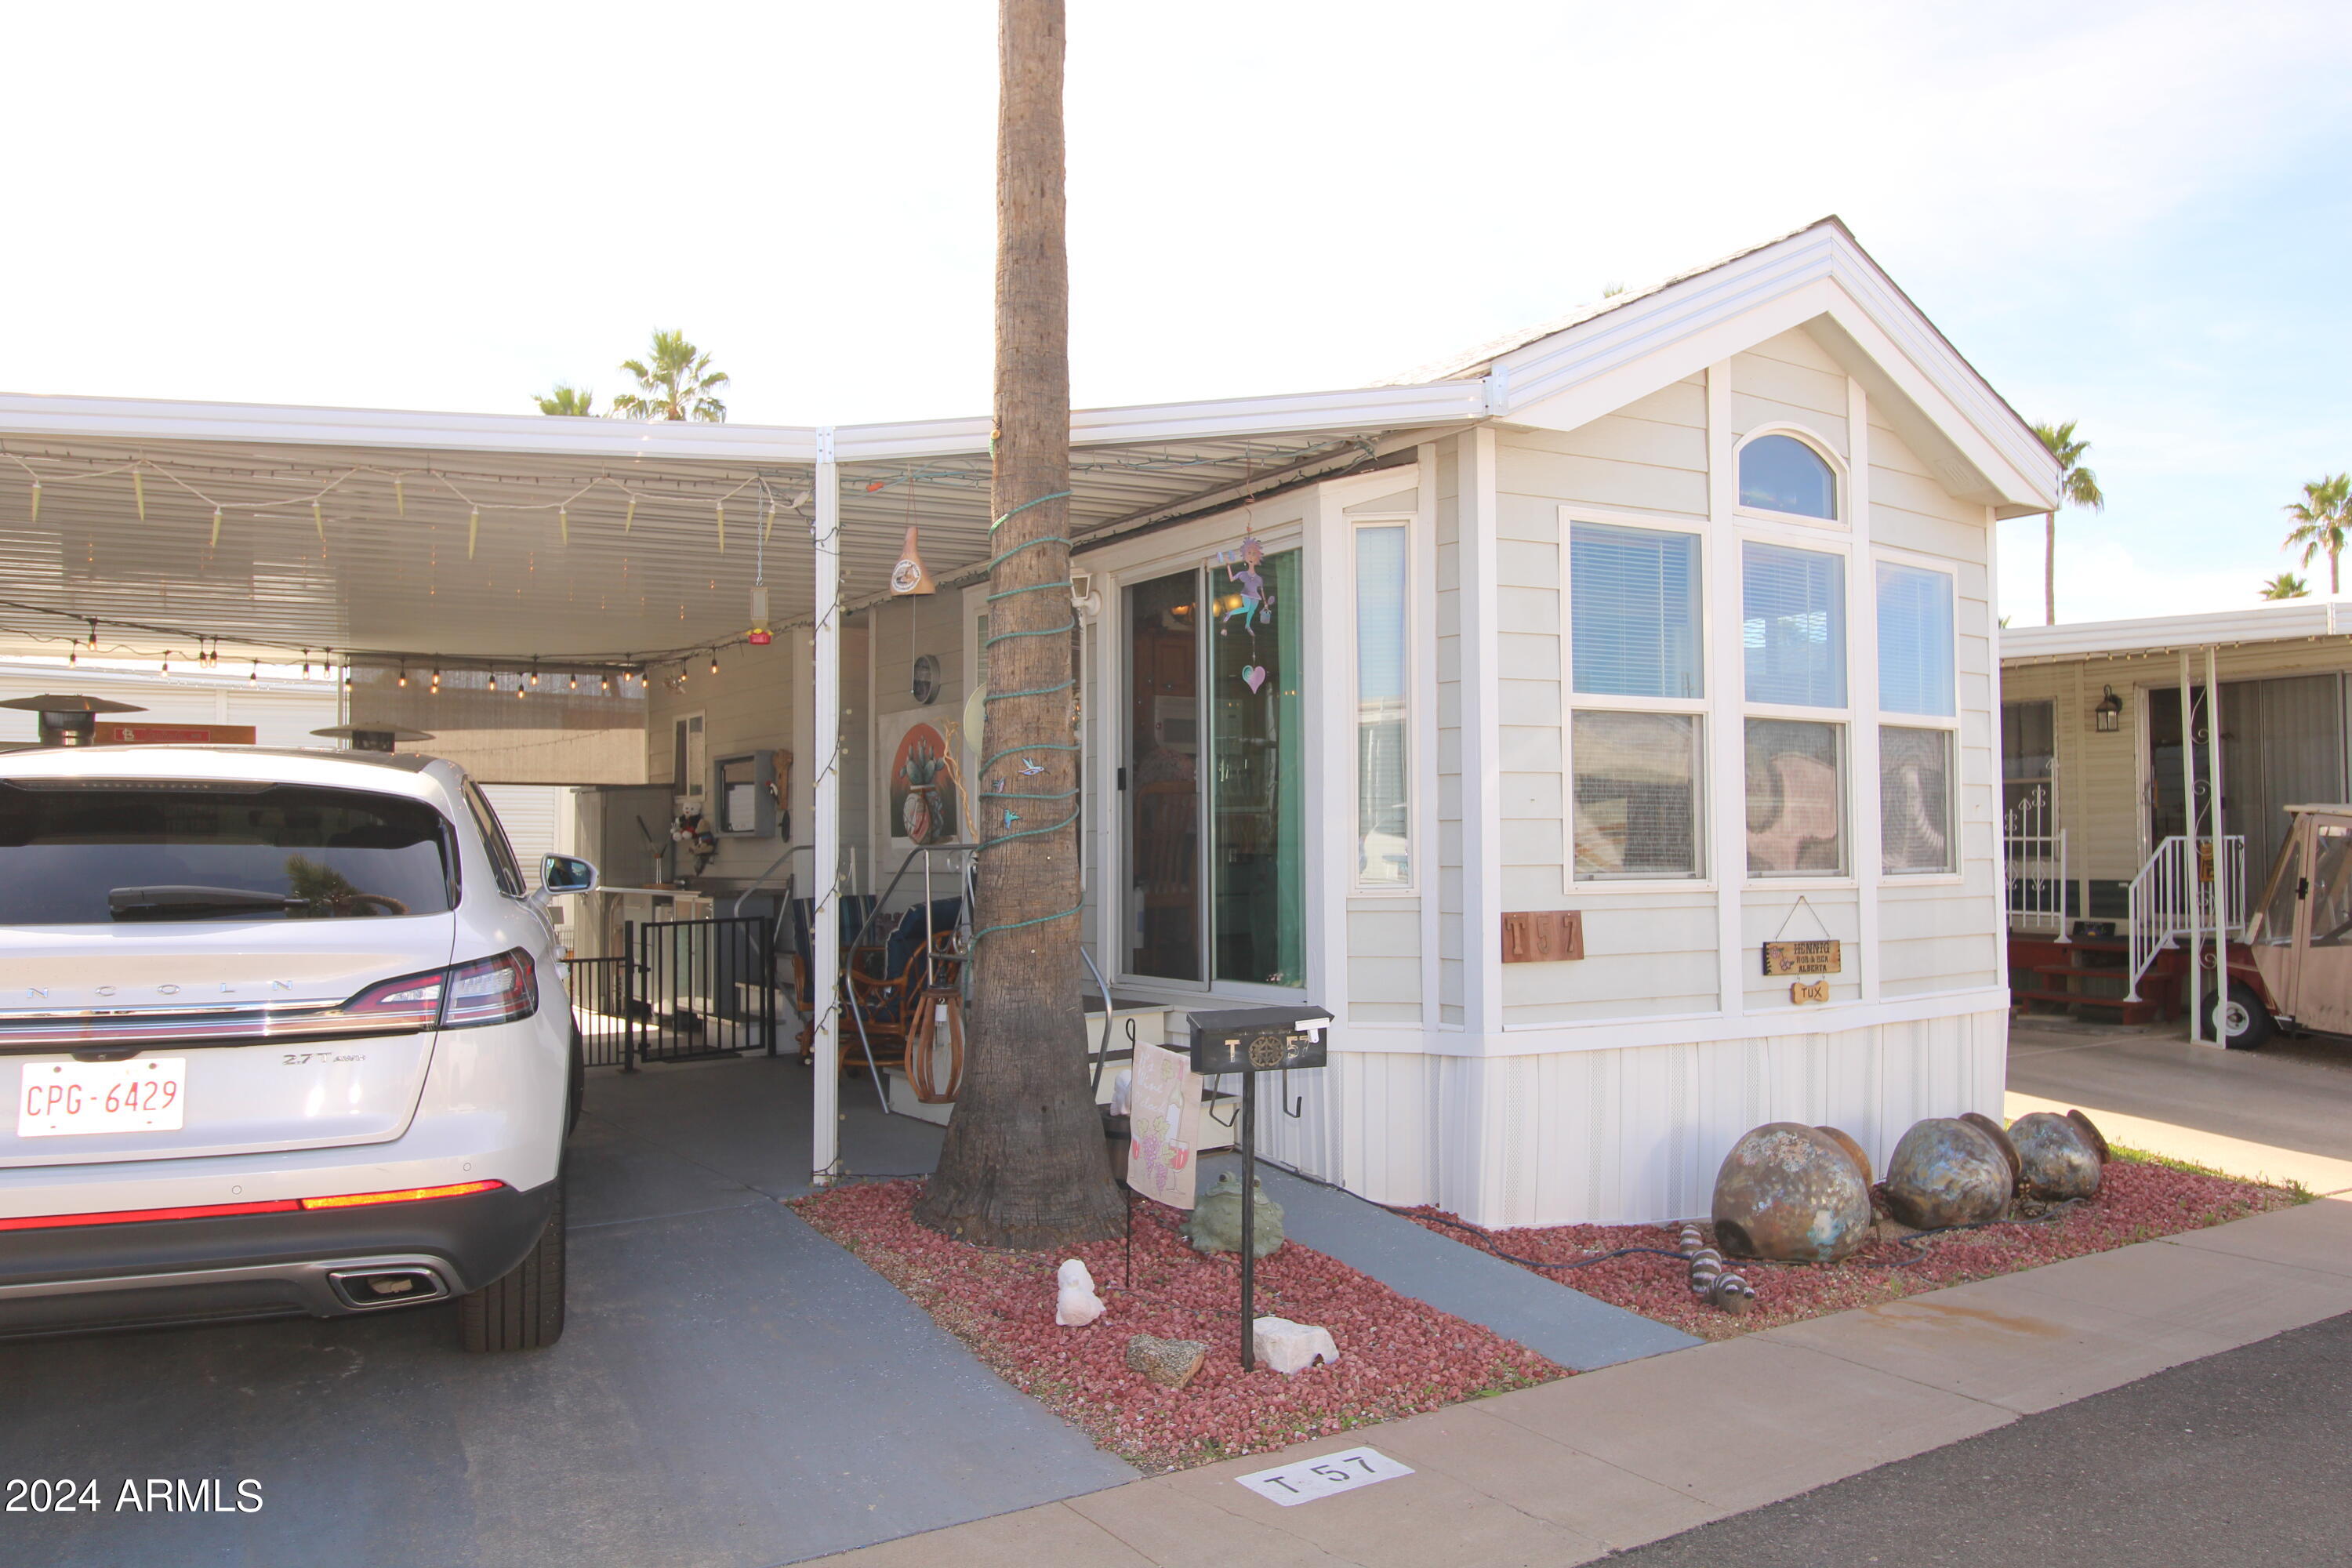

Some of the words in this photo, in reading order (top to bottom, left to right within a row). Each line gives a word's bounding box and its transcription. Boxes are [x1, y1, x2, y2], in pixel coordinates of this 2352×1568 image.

[1794, 942, 1830, 955] HENNIG
[1798, 964, 1827, 973] ALBERTA
[1801, 986, 1822, 998] TUX
[1225, 1039, 1241, 1063] T
[27, 1080, 177, 1116] CPG-6429
